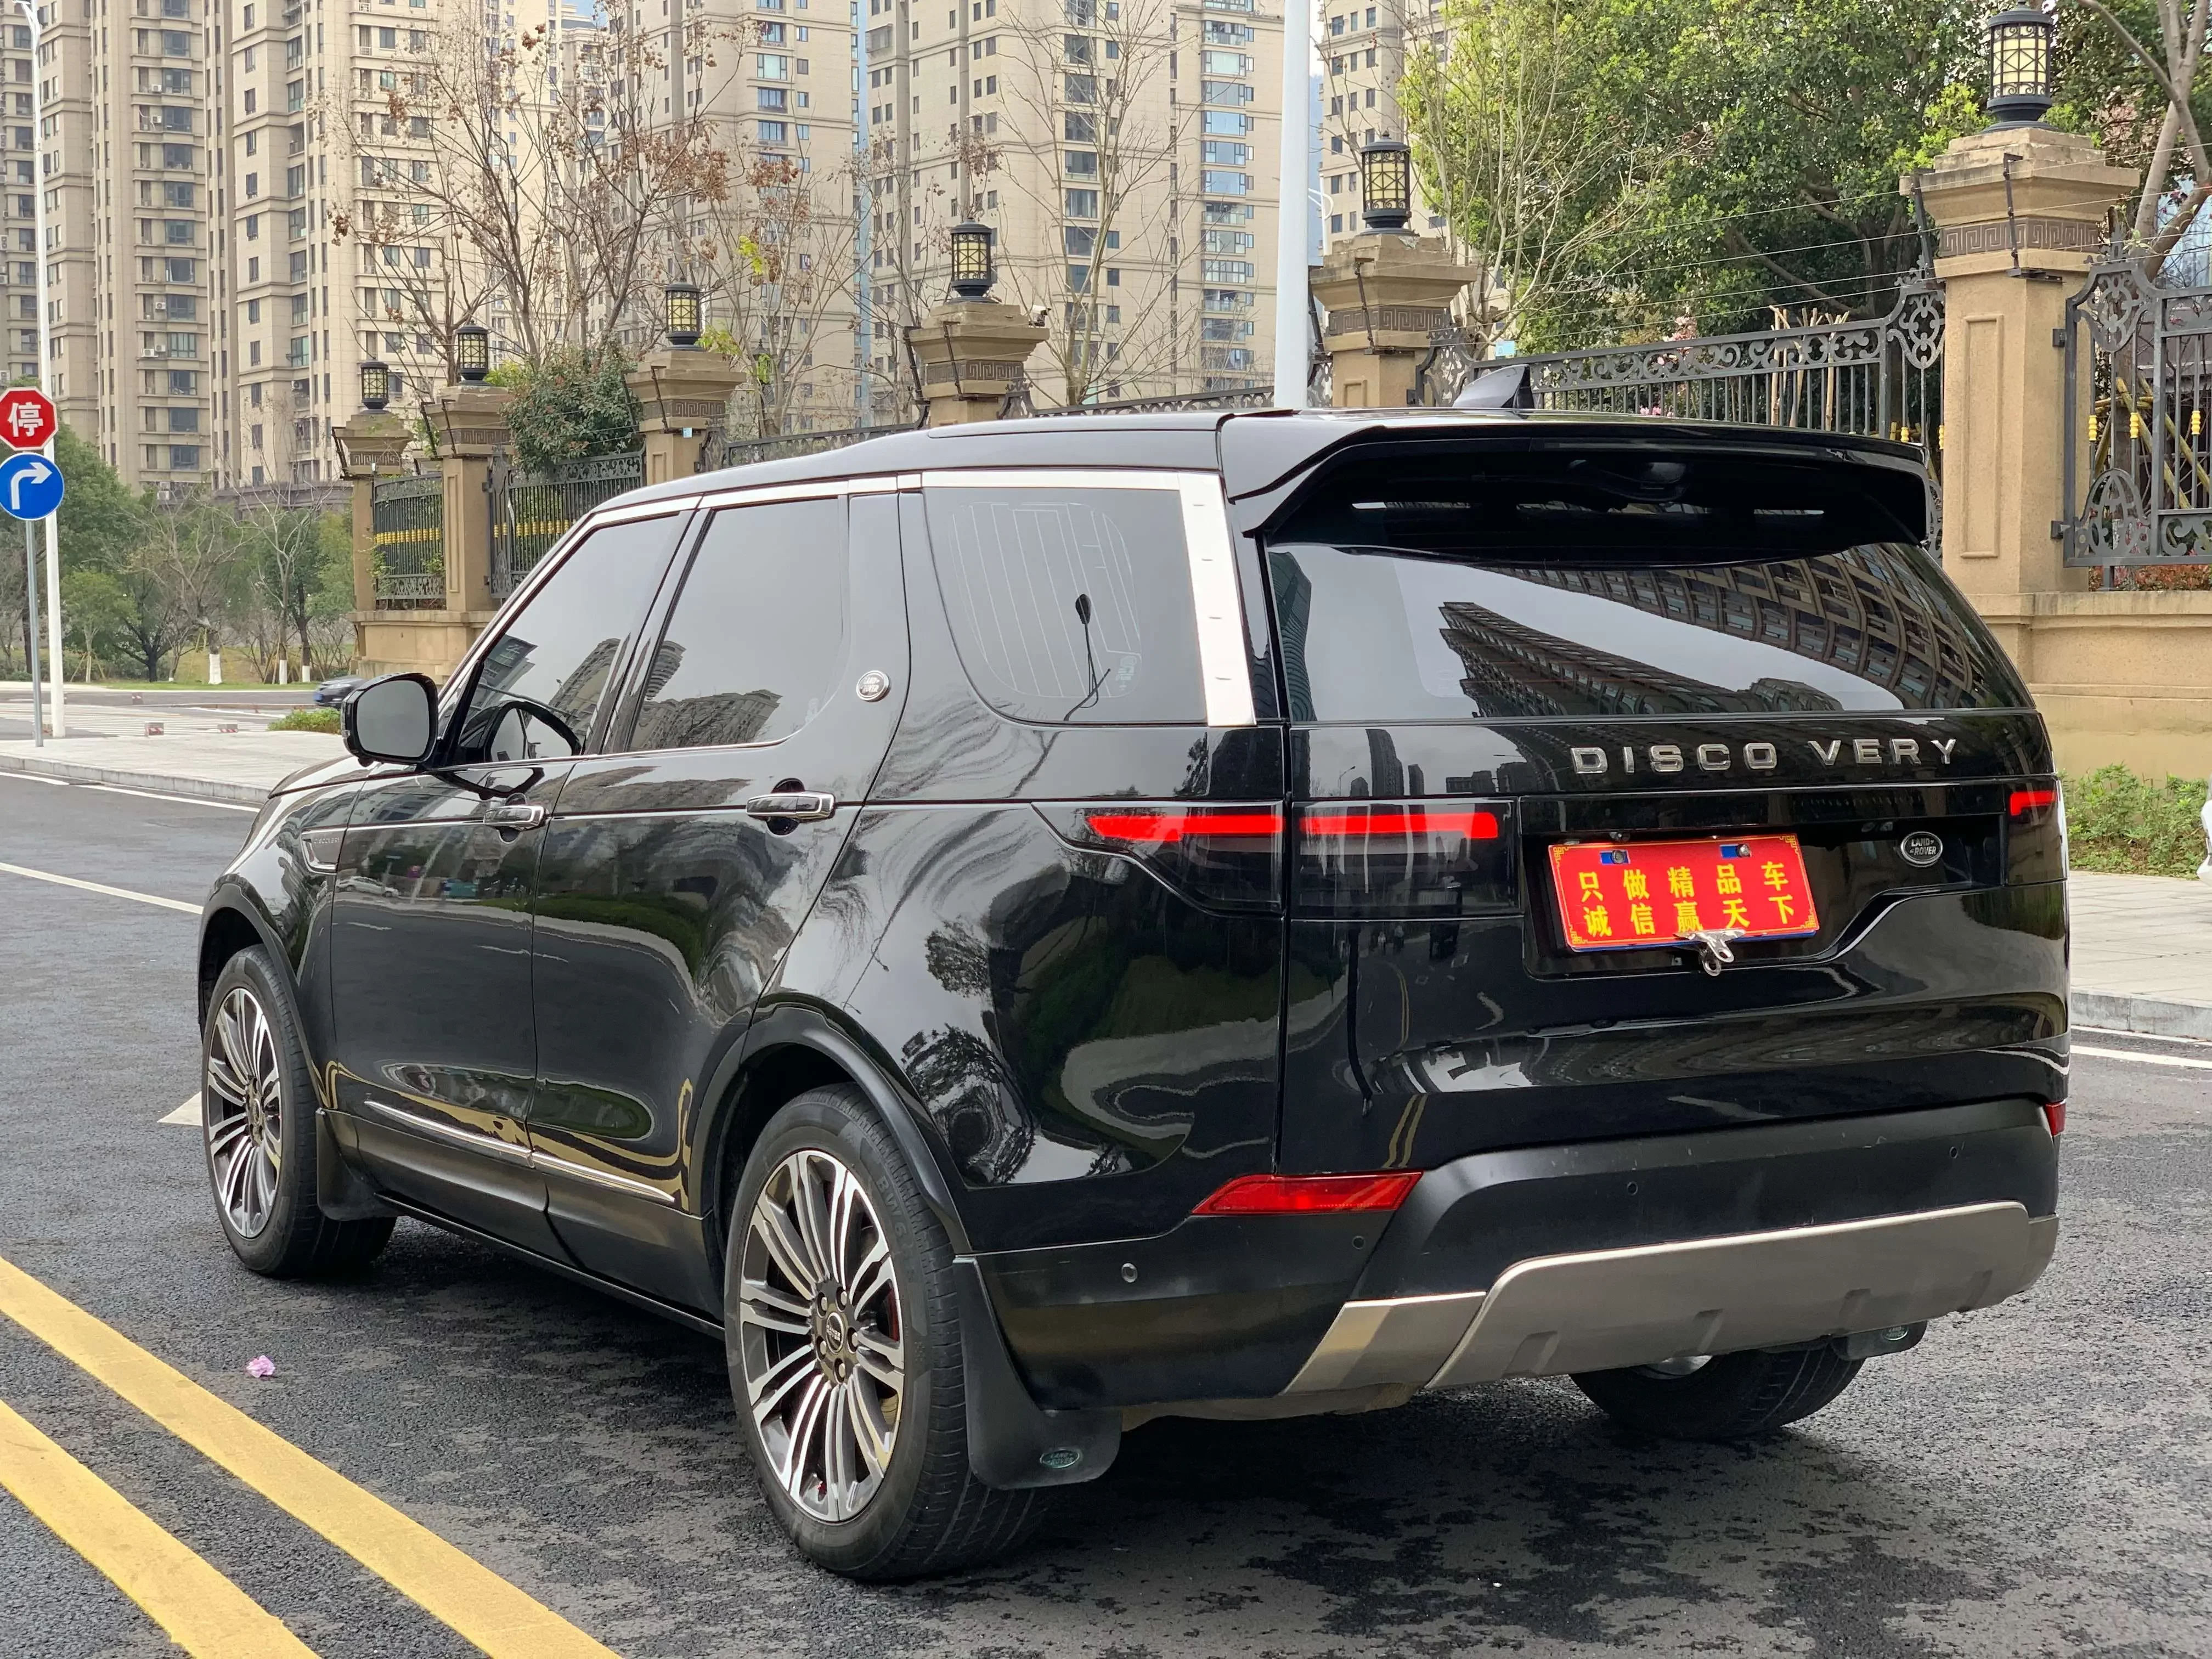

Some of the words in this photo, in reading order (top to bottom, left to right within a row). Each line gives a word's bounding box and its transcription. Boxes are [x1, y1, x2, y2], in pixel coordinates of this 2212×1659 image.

[7, 402, 43, 437] 停
[1911, 838, 1930, 847] LAND
[1914, 847, 1937, 855] ROVER
[1578, 861, 1789, 902] 只做精品车
